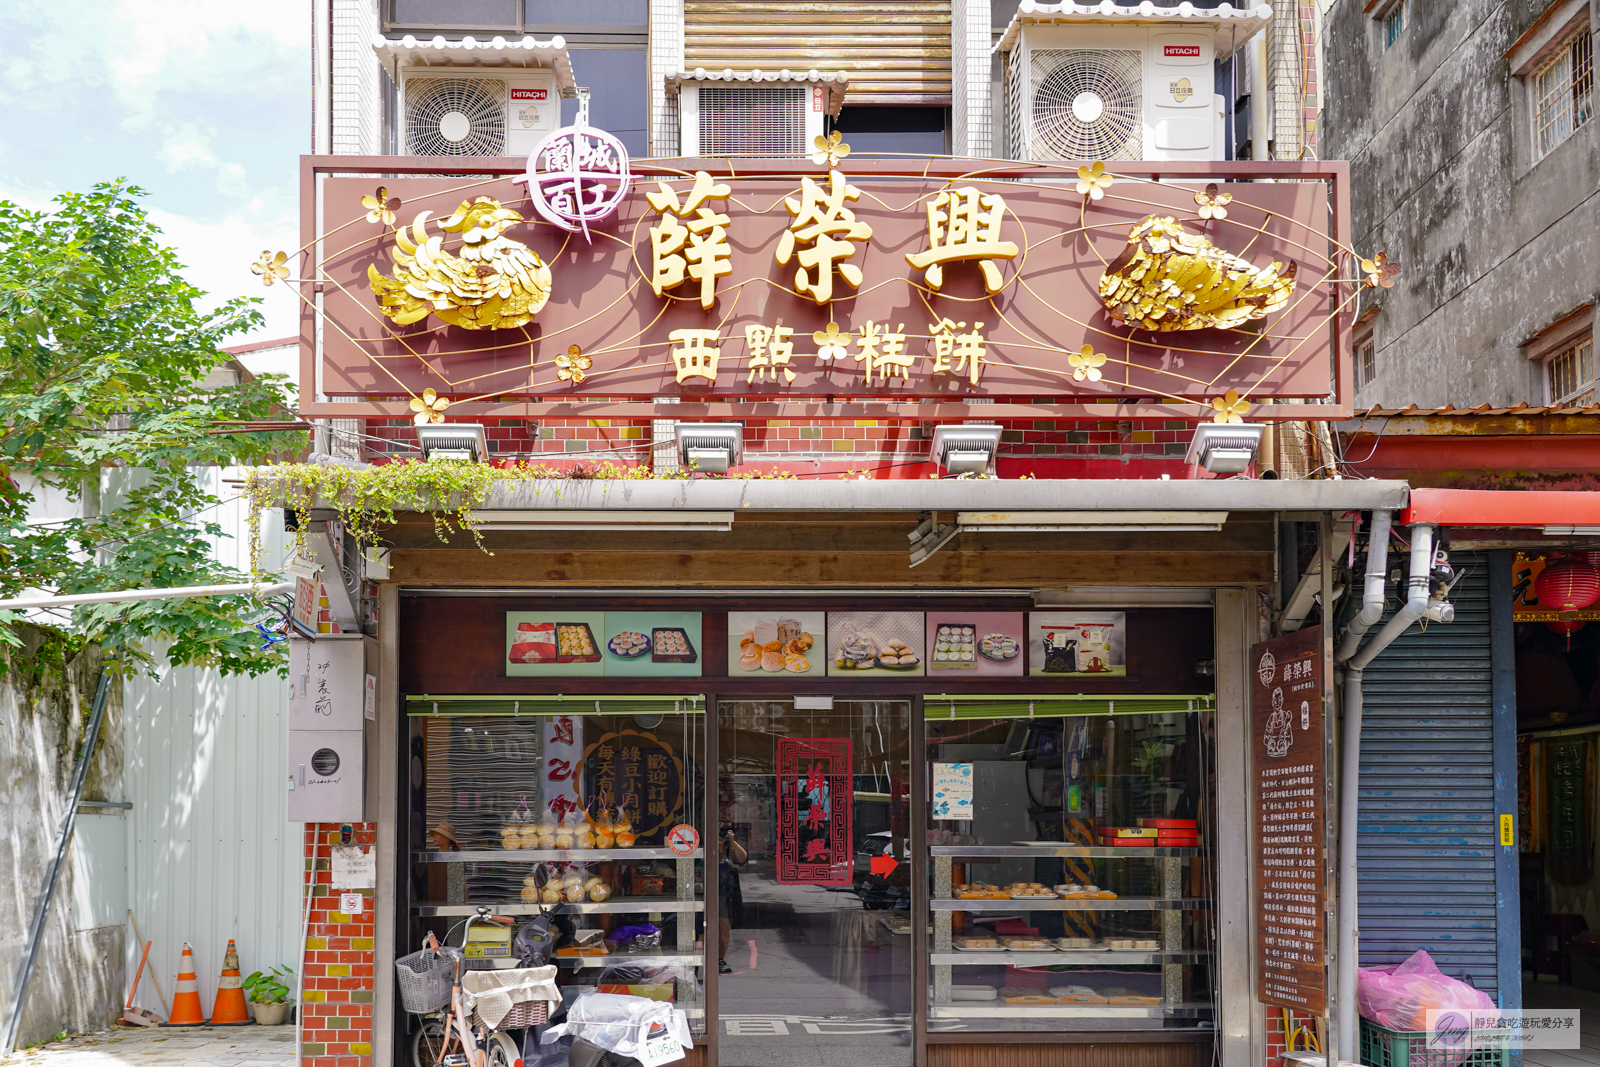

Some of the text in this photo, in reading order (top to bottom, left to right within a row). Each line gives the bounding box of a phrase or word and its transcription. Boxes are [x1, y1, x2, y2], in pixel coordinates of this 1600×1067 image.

[814, 97, 821, 111] 日立
[545, 136, 617, 173] 蘭城
[544, 181, 608, 214] 百工
[646, 169, 1019, 310] 薛榮興
[1283, 659, 1313, 682] 薛榮興
[621, 746, 642, 825] 綠豆小月餅
[646, 754, 668, 816] 歡迎訂購
[803, 762, 830, 862] 薛榮興
